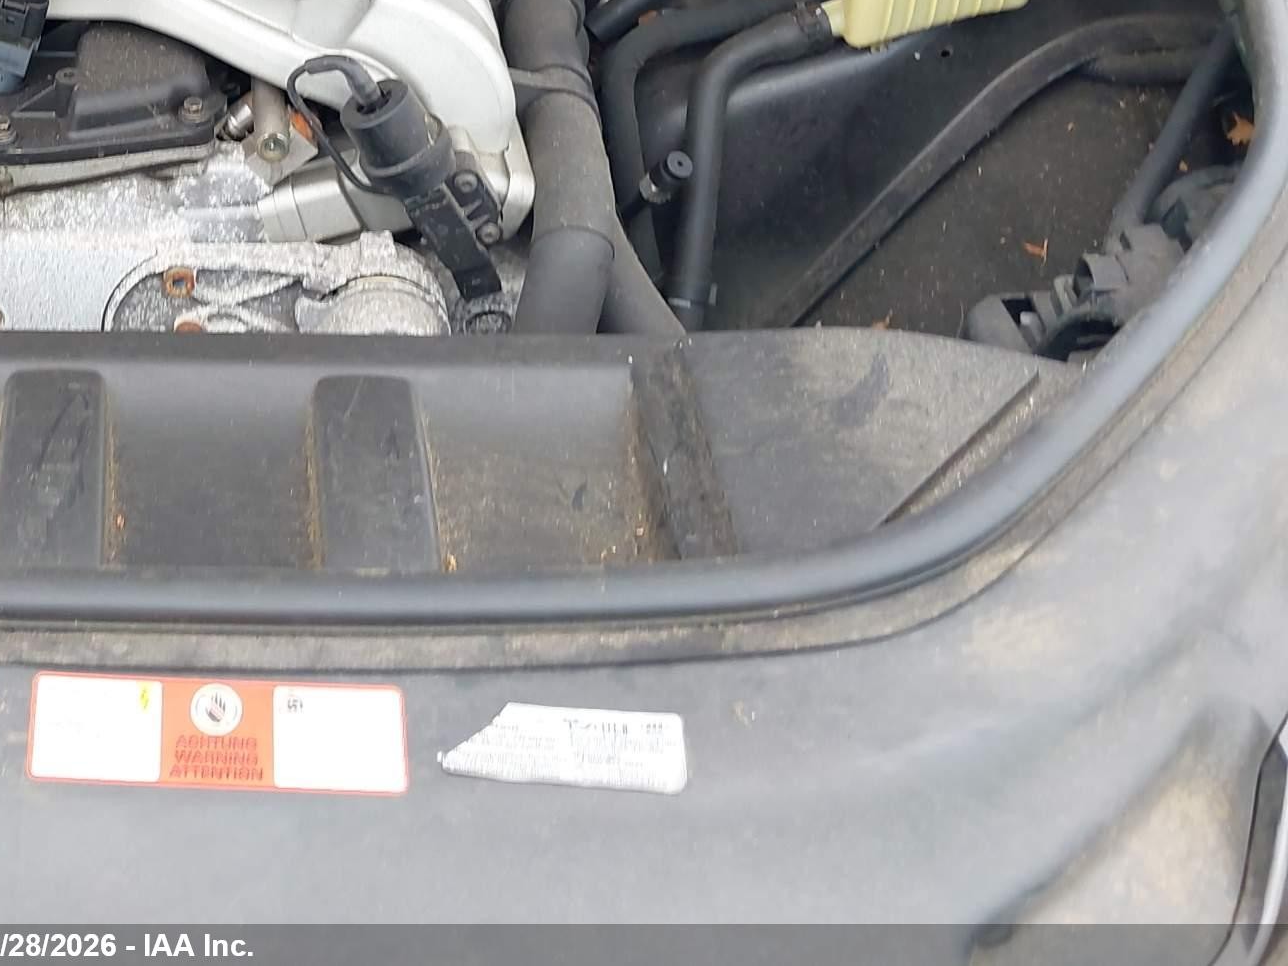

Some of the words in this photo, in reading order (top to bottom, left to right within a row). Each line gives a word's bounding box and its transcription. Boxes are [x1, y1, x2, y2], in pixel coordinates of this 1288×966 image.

[175, 734, 257, 750] ACHTUNG
[174, 749, 259, 765] WARNING
[169, 764, 264, 781] ATTENTION
